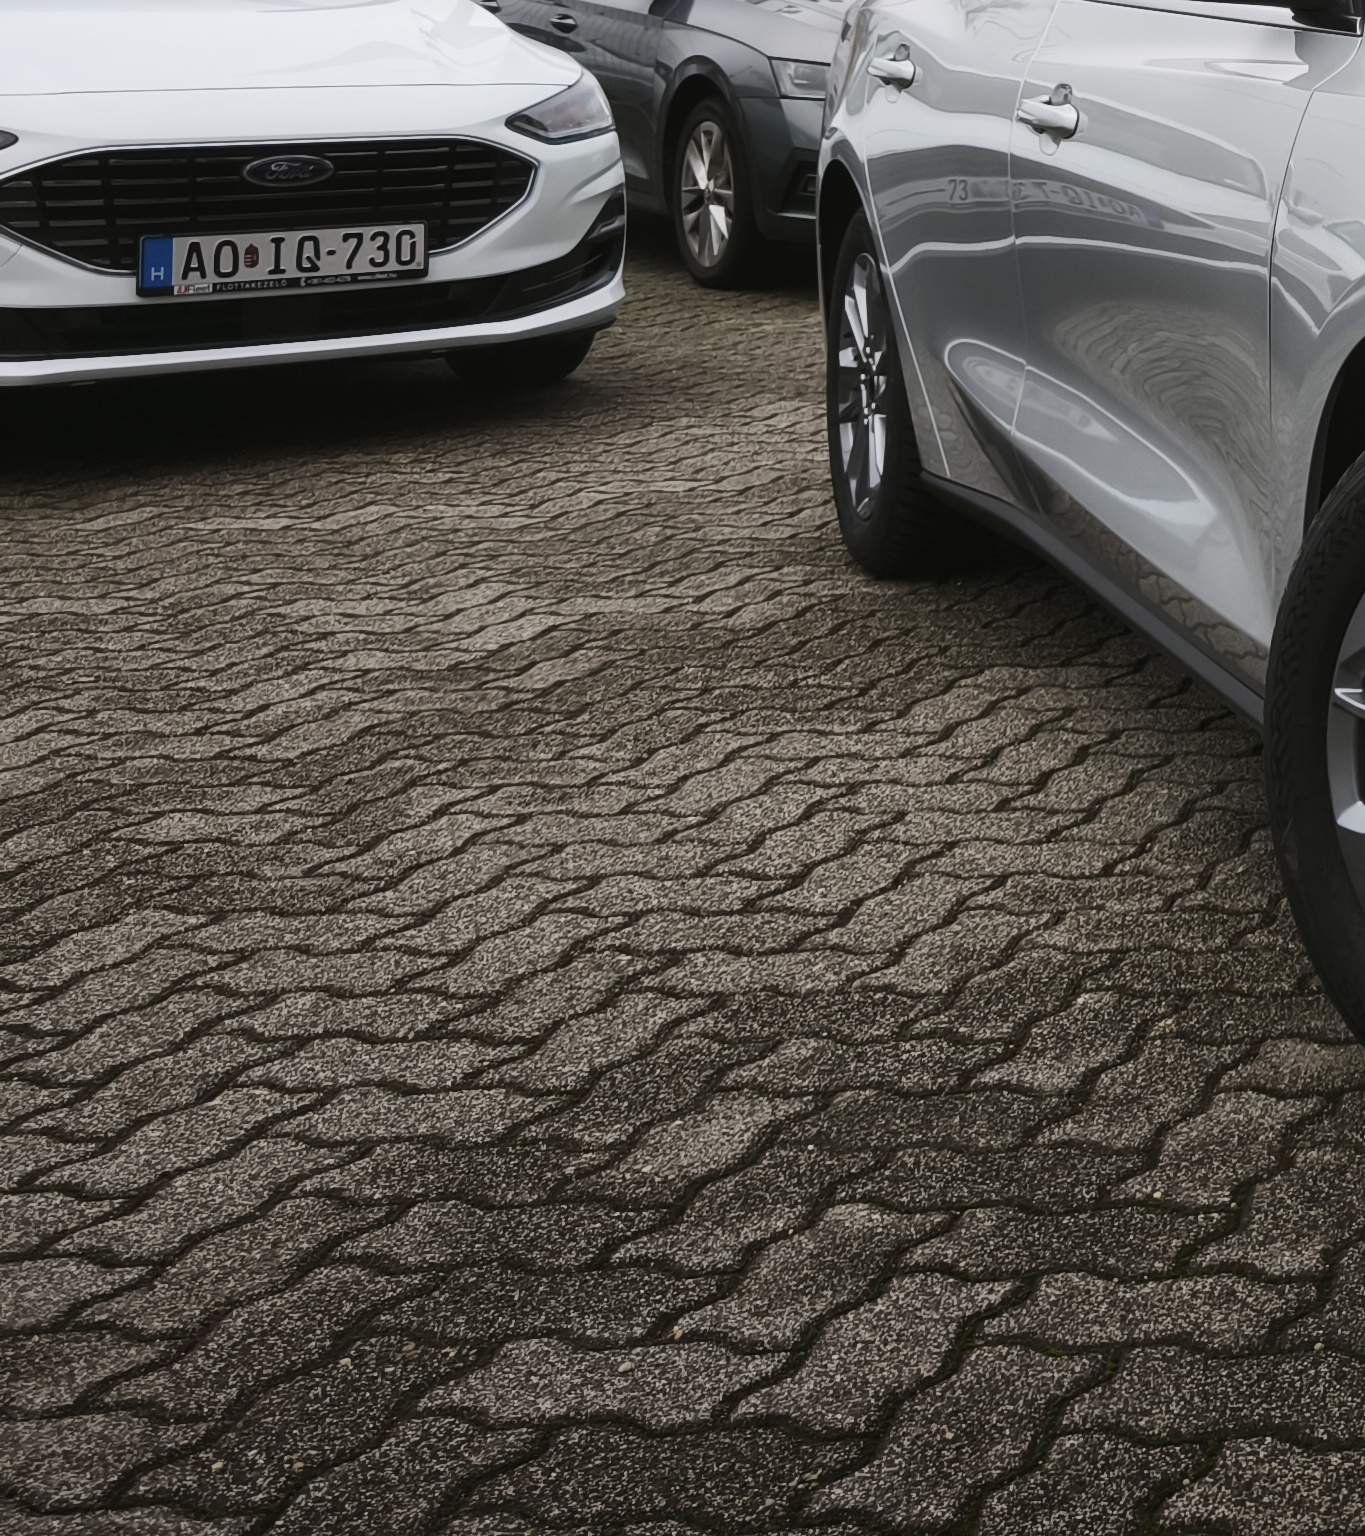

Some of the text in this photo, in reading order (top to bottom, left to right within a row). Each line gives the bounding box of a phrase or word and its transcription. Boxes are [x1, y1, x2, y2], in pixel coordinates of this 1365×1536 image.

[265, 161, 314, 180] Ford
[181, 240, 239, 281] AO
[150, 266, 164, 282] H
